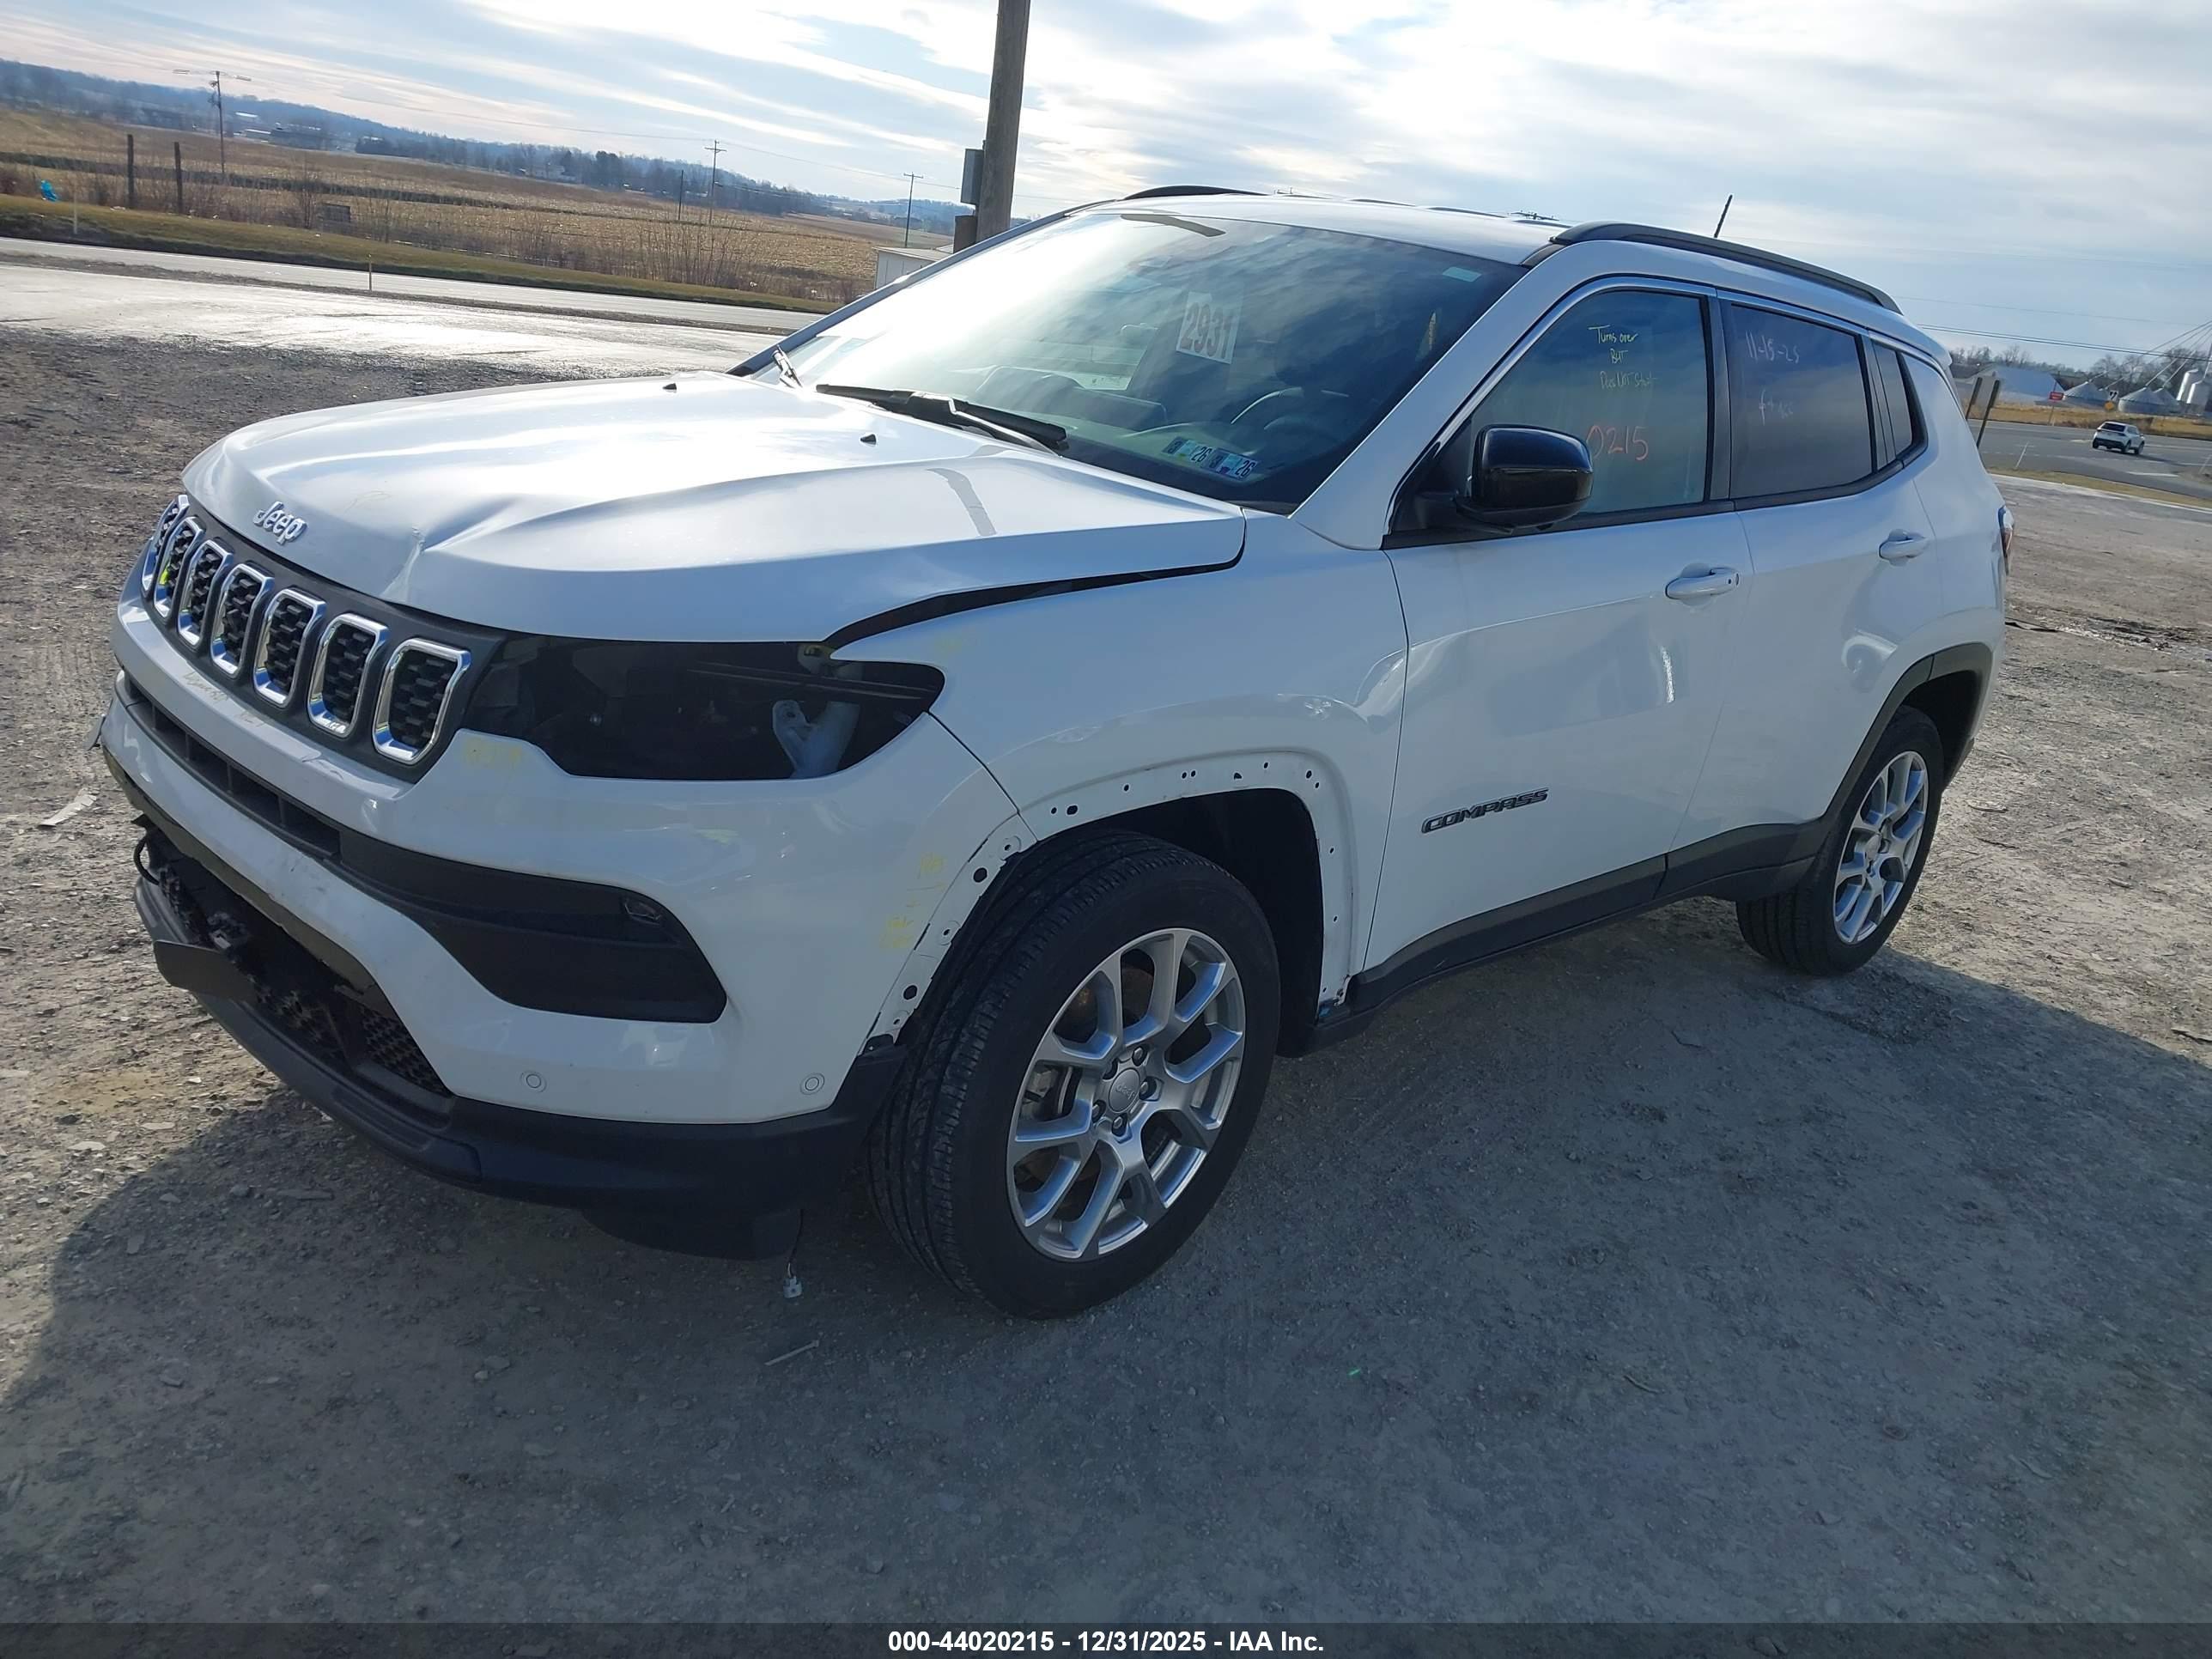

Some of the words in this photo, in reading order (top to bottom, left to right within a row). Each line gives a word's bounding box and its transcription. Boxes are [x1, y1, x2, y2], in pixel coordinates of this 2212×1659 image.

[1181, 302, 1233, 359] 2931
[1587, 324, 1617, 344] Turns
[1190, 446, 1213, 463] 26
[1586, 425, 1650, 461] 0215
[1234, 459, 1256, 477] 26
[252, 501, 308, 546] Jeep
[1421, 788, 1549, 834] COMPASS
